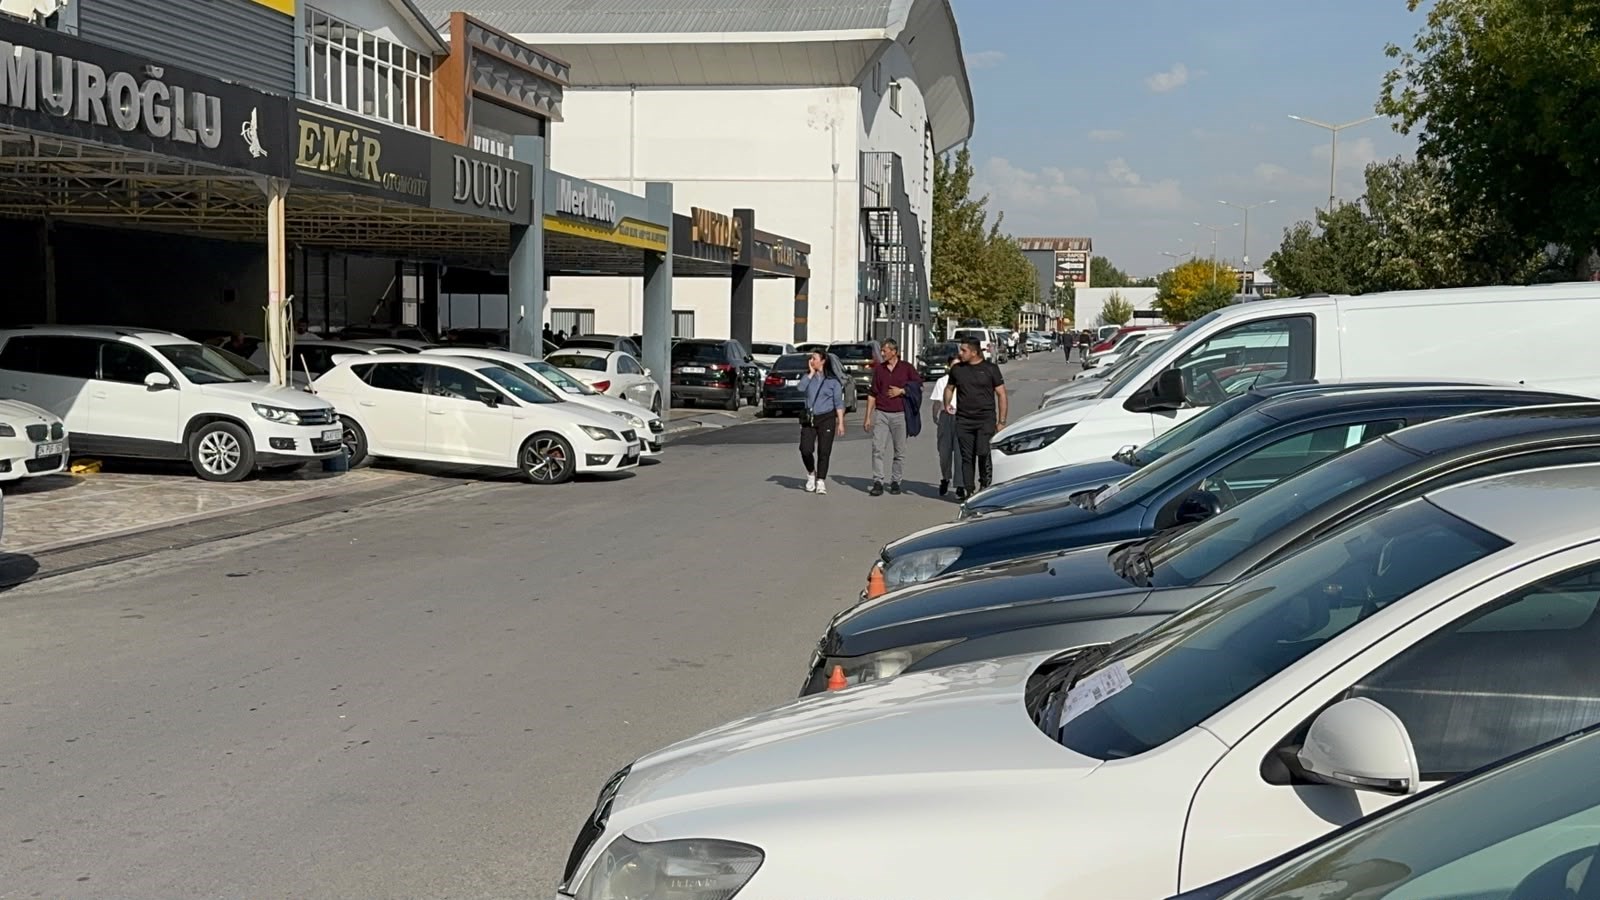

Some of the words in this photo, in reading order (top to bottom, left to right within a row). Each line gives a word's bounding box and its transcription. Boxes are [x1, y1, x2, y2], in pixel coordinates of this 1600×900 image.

[453, 154, 519, 212] DURU
[556, 179, 589, 217] Mert
[590, 187, 616, 223] Auto
